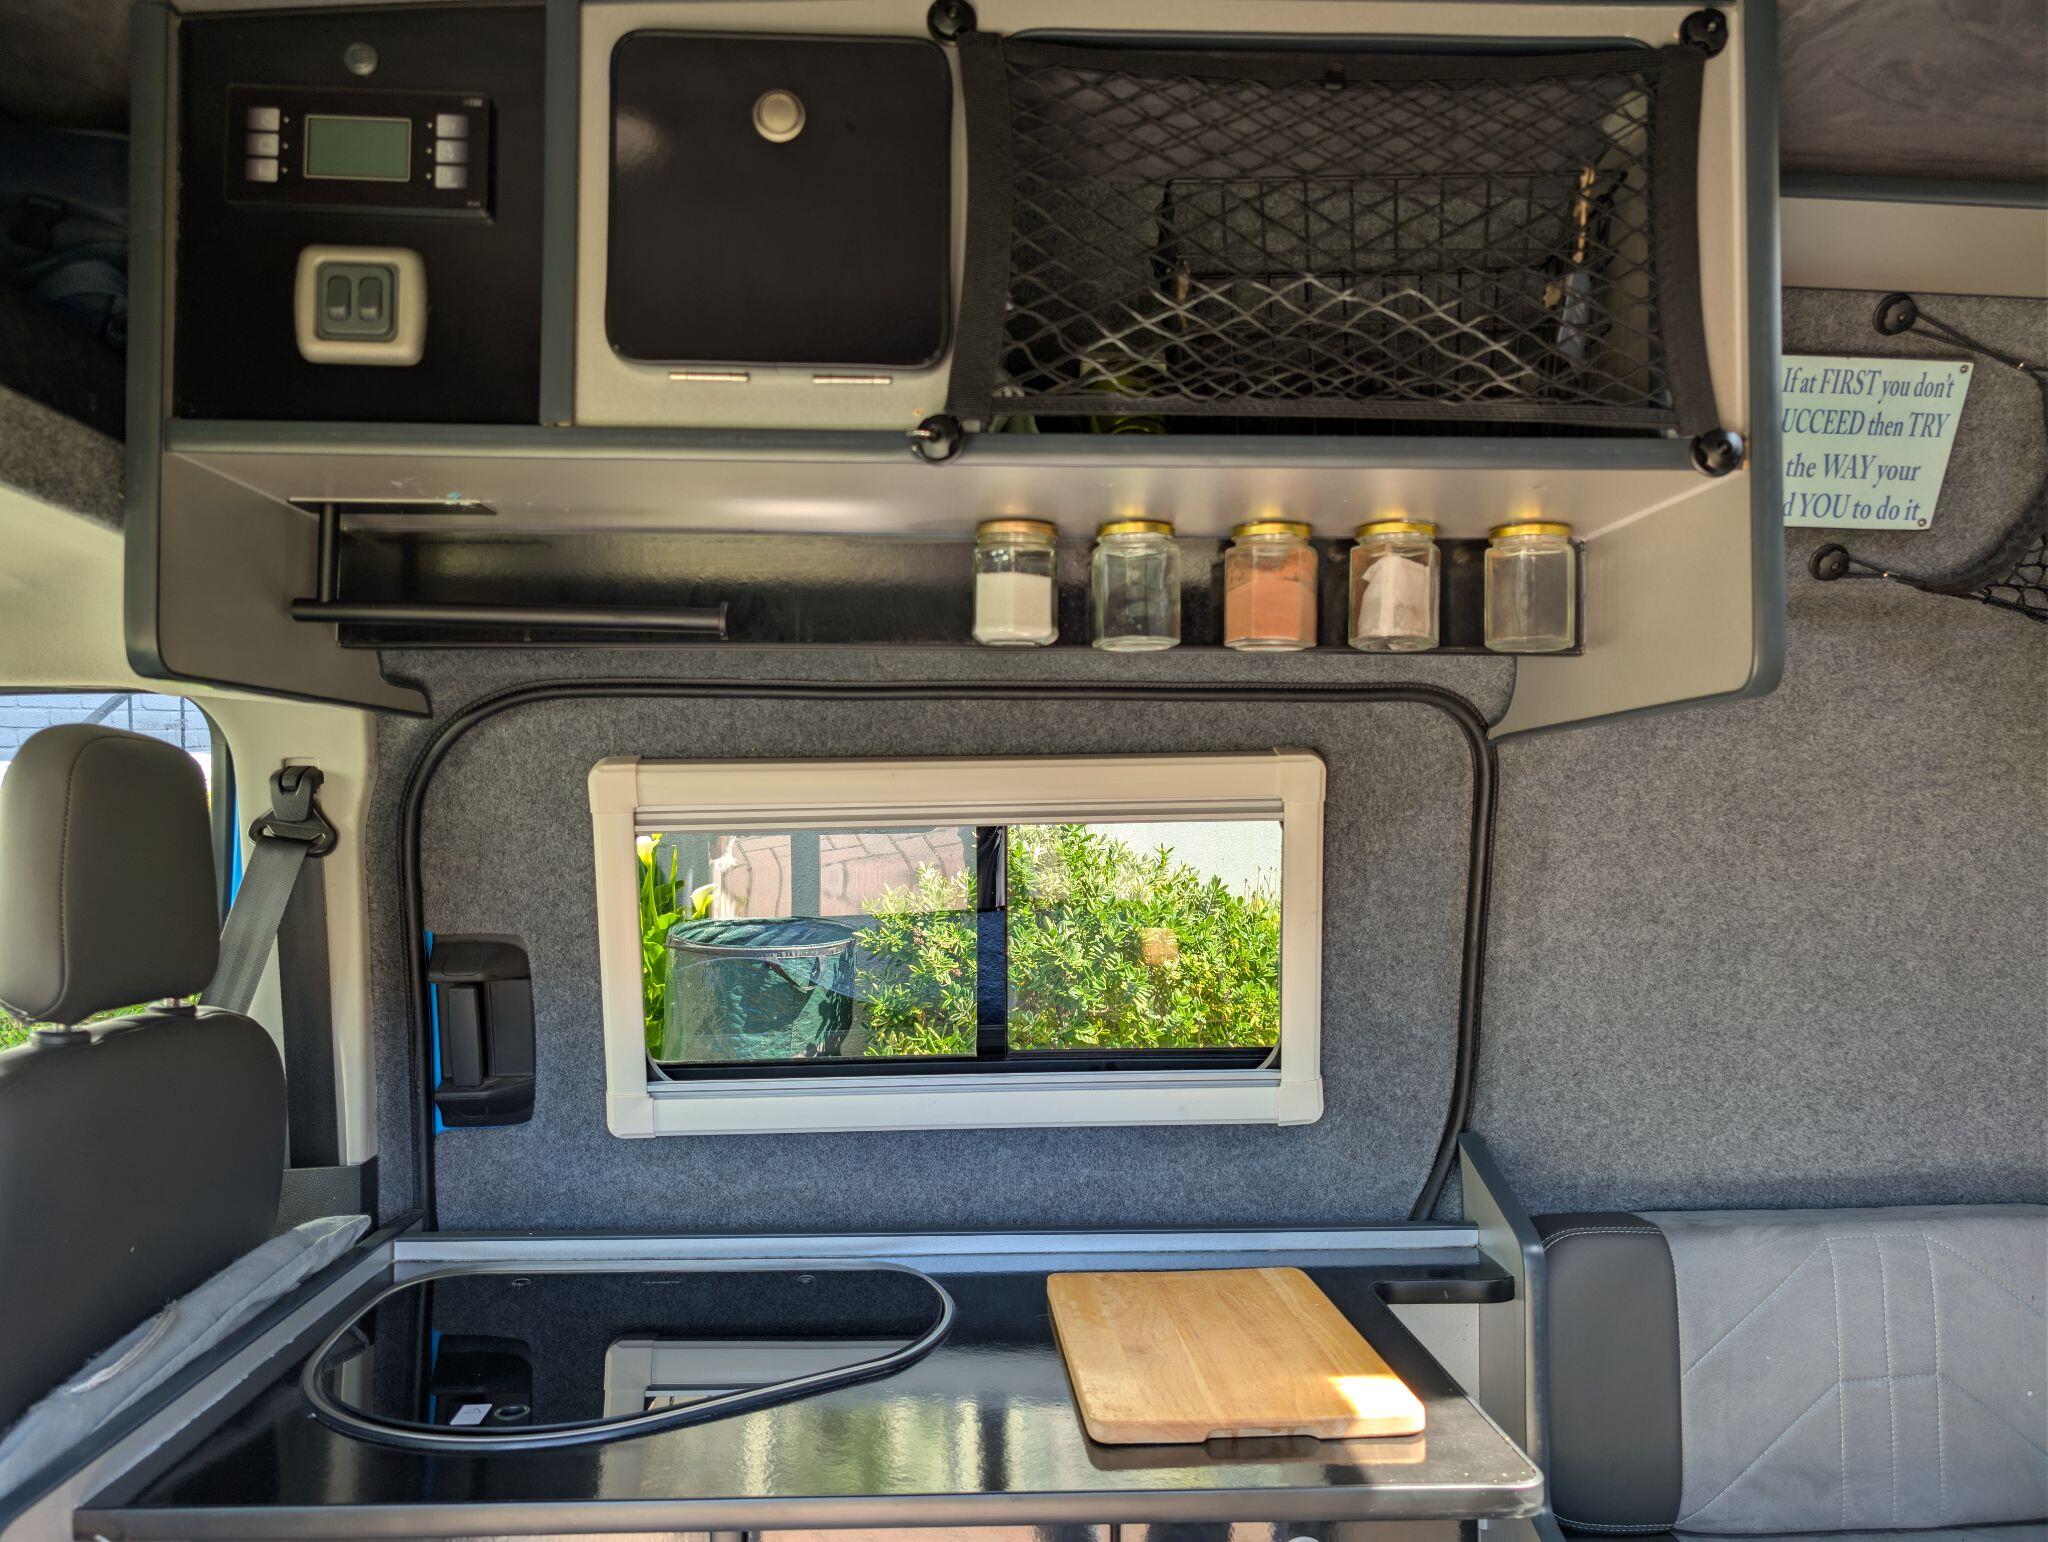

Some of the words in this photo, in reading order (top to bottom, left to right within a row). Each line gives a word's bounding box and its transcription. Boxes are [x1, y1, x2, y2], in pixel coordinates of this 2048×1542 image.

[1782, 367, 1803, 393] If
[1799, 374, 1818, 393] at
[1819, 368, 1882, 395] FIRST
[1877, 378, 1911, 404] you
[1913, 372, 1955, 399] don't
[1781, 407, 1865, 435] UCCEED
[1867, 410, 1904, 437] then
[1908, 412, 1951, 438] TRY
[1785, 453, 1817, 478] the
[1823, 453, 1878, 480] WAY
[1872, 464, 1922, 489] your
[1798, 493, 1852, 519] YOU
[1852, 500, 1872, 520] to
[1876, 495, 1900, 521] do
[1903, 499, 1921, 521] it
